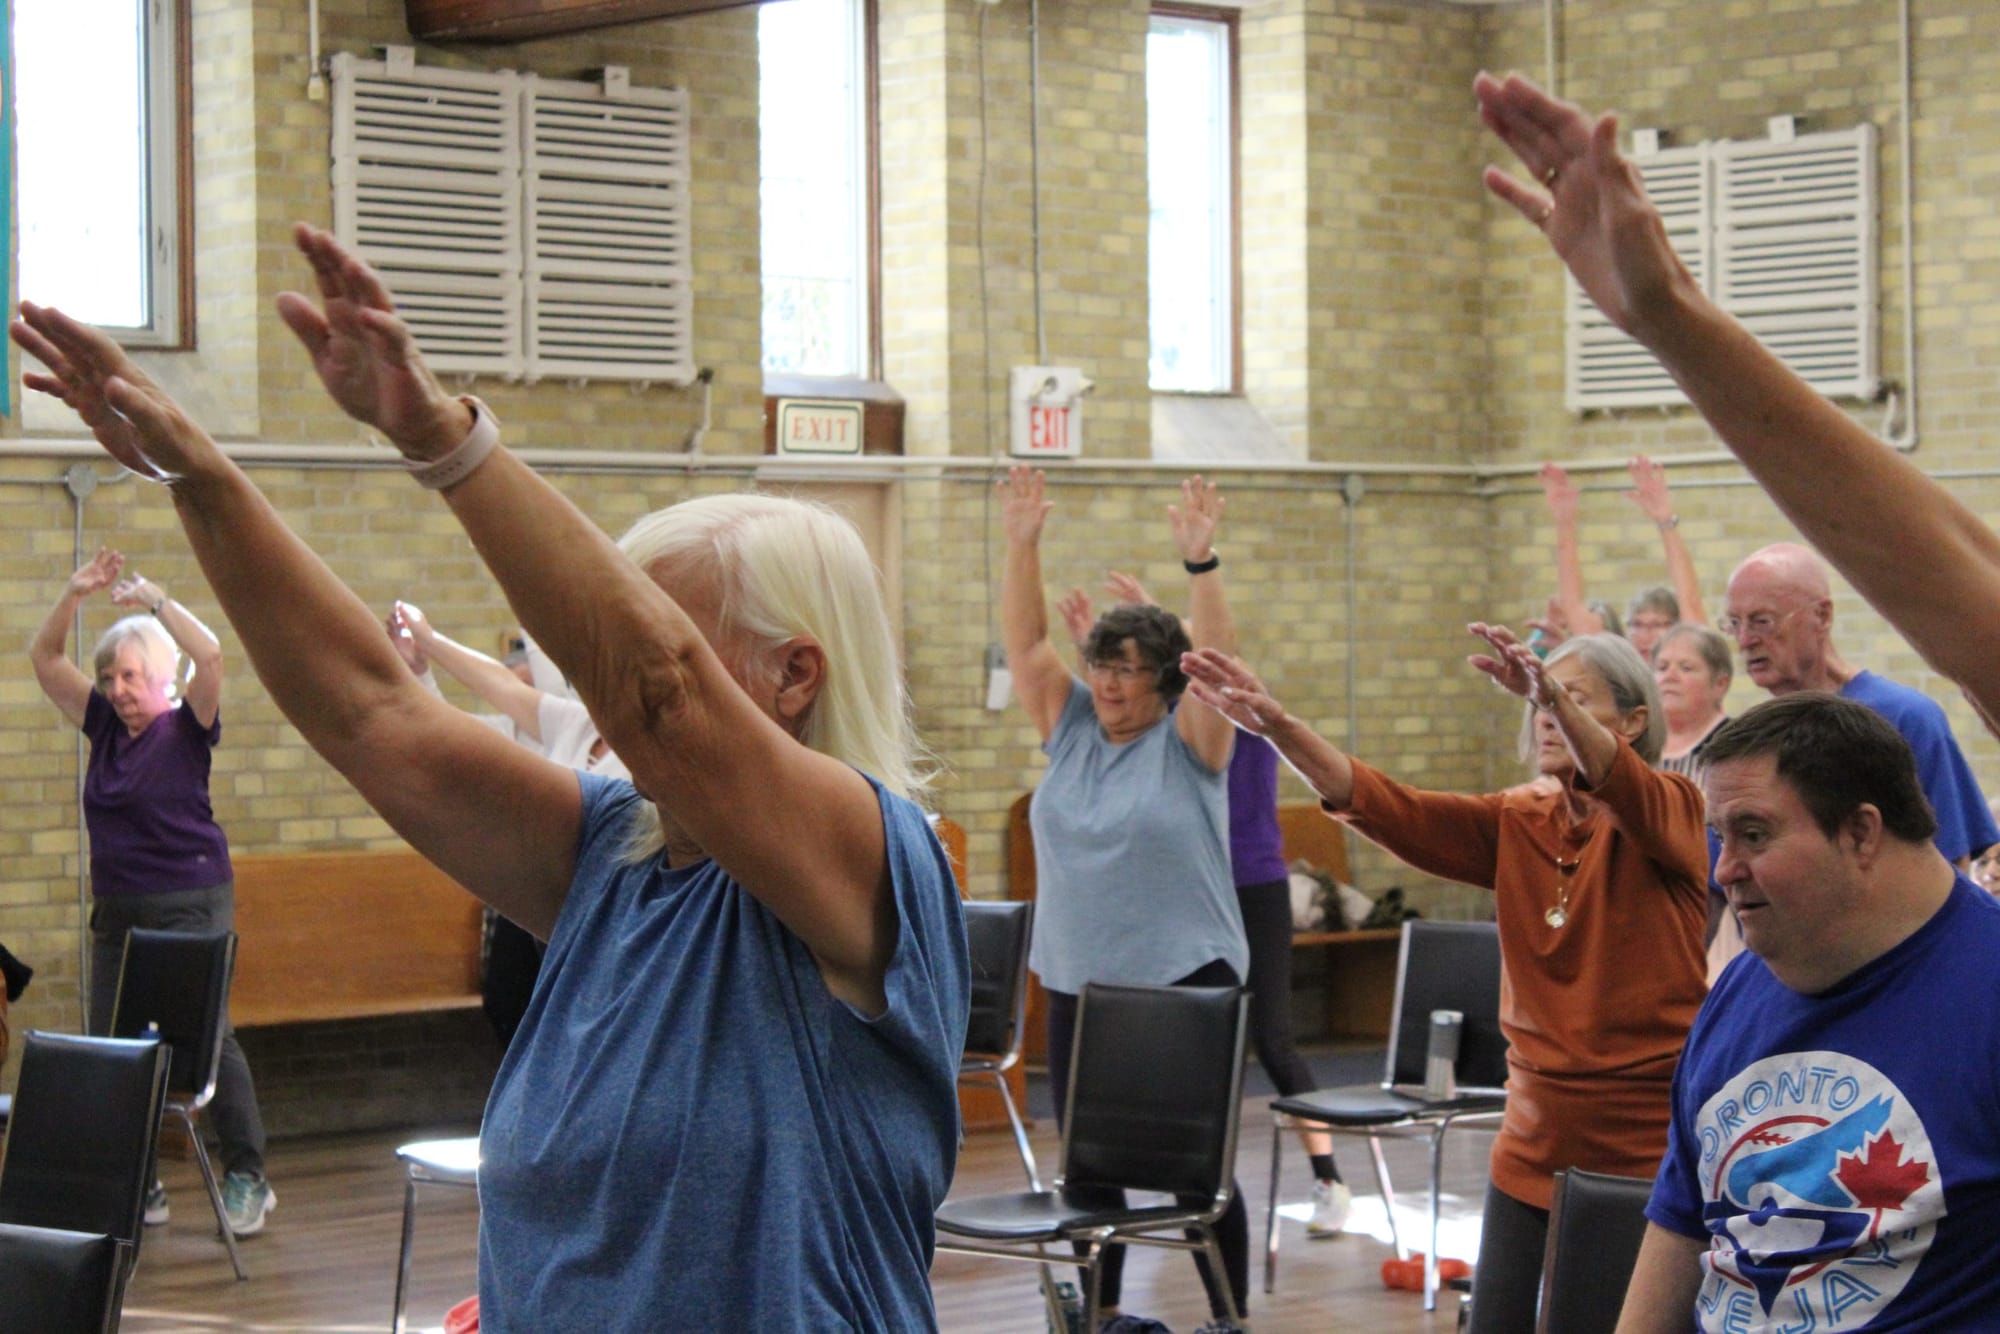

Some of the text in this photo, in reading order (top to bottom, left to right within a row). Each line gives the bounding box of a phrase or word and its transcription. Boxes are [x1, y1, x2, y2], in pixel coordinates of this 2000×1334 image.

[793, 415, 849, 442] EXIT
[1030, 405, 1070, 449] EXIT
[1701, 1066, 1860, 1187] ORONTO
[1776, 1227, 1917, 1334] JAY
